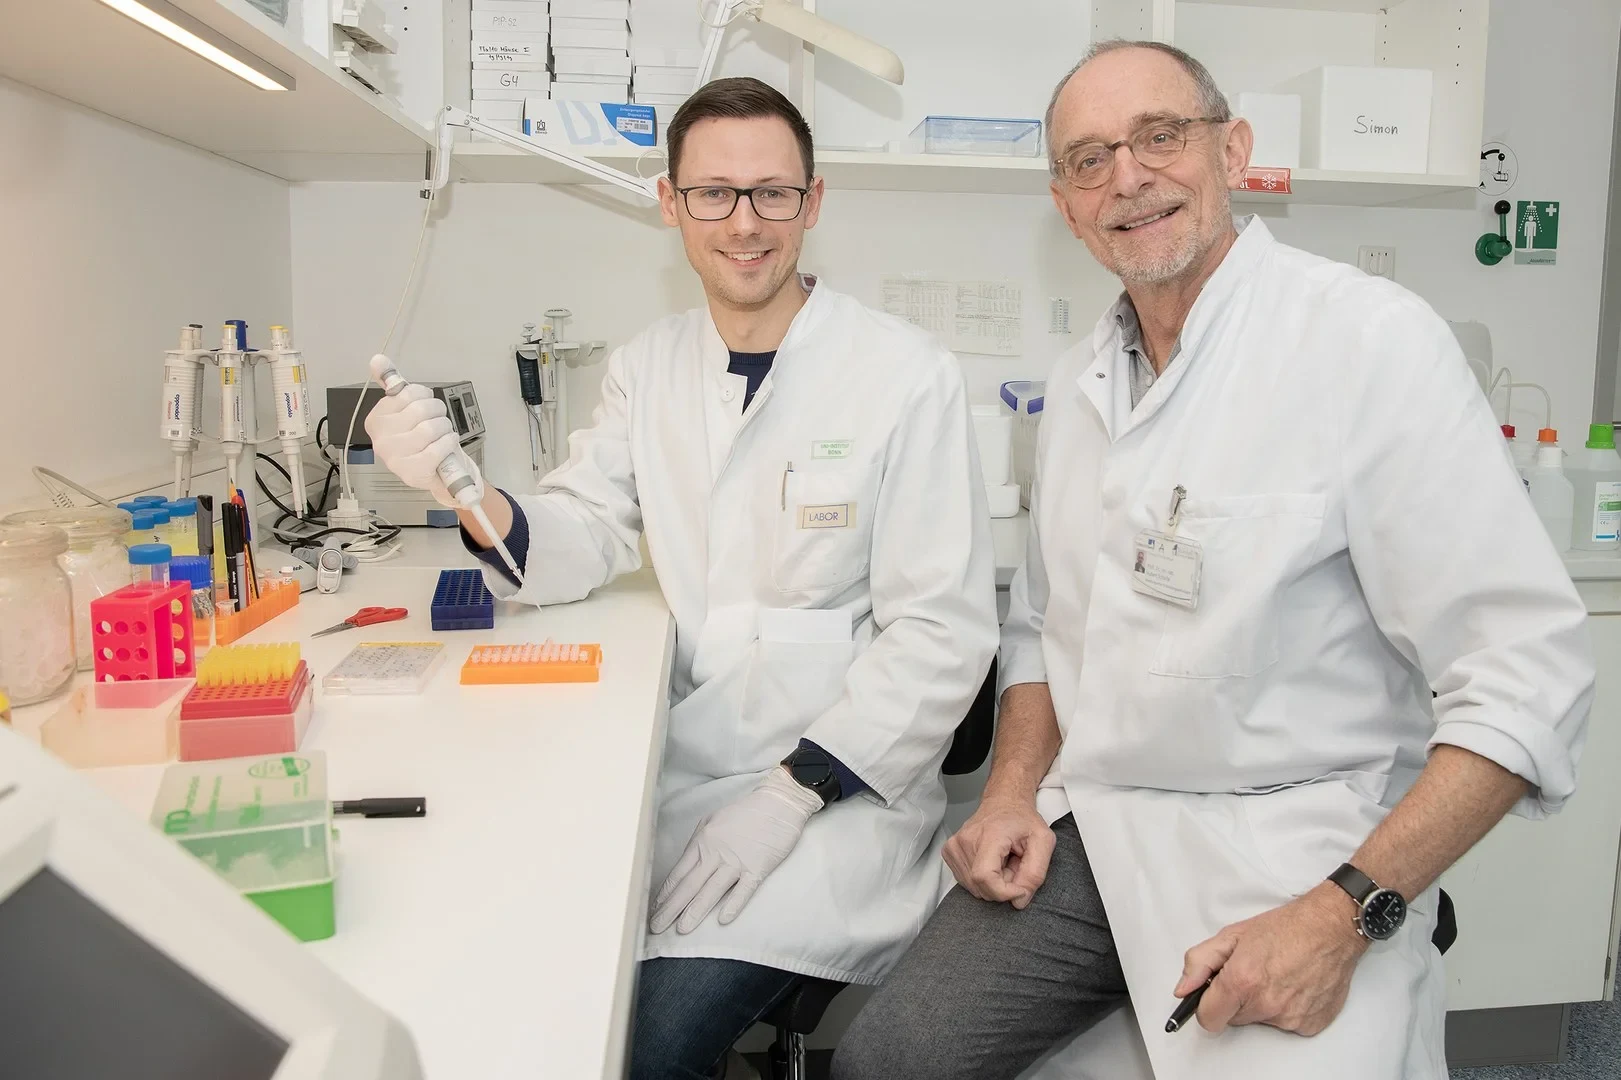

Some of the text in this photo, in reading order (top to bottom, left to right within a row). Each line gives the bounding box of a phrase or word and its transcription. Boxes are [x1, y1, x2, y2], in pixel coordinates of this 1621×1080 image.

[500, 73, 518, 87] G4
[1353, 115, 1398, 135] Simon
[284, 392, 292, 418] eppendorf
[809, 512, 839, 522] LABOR
